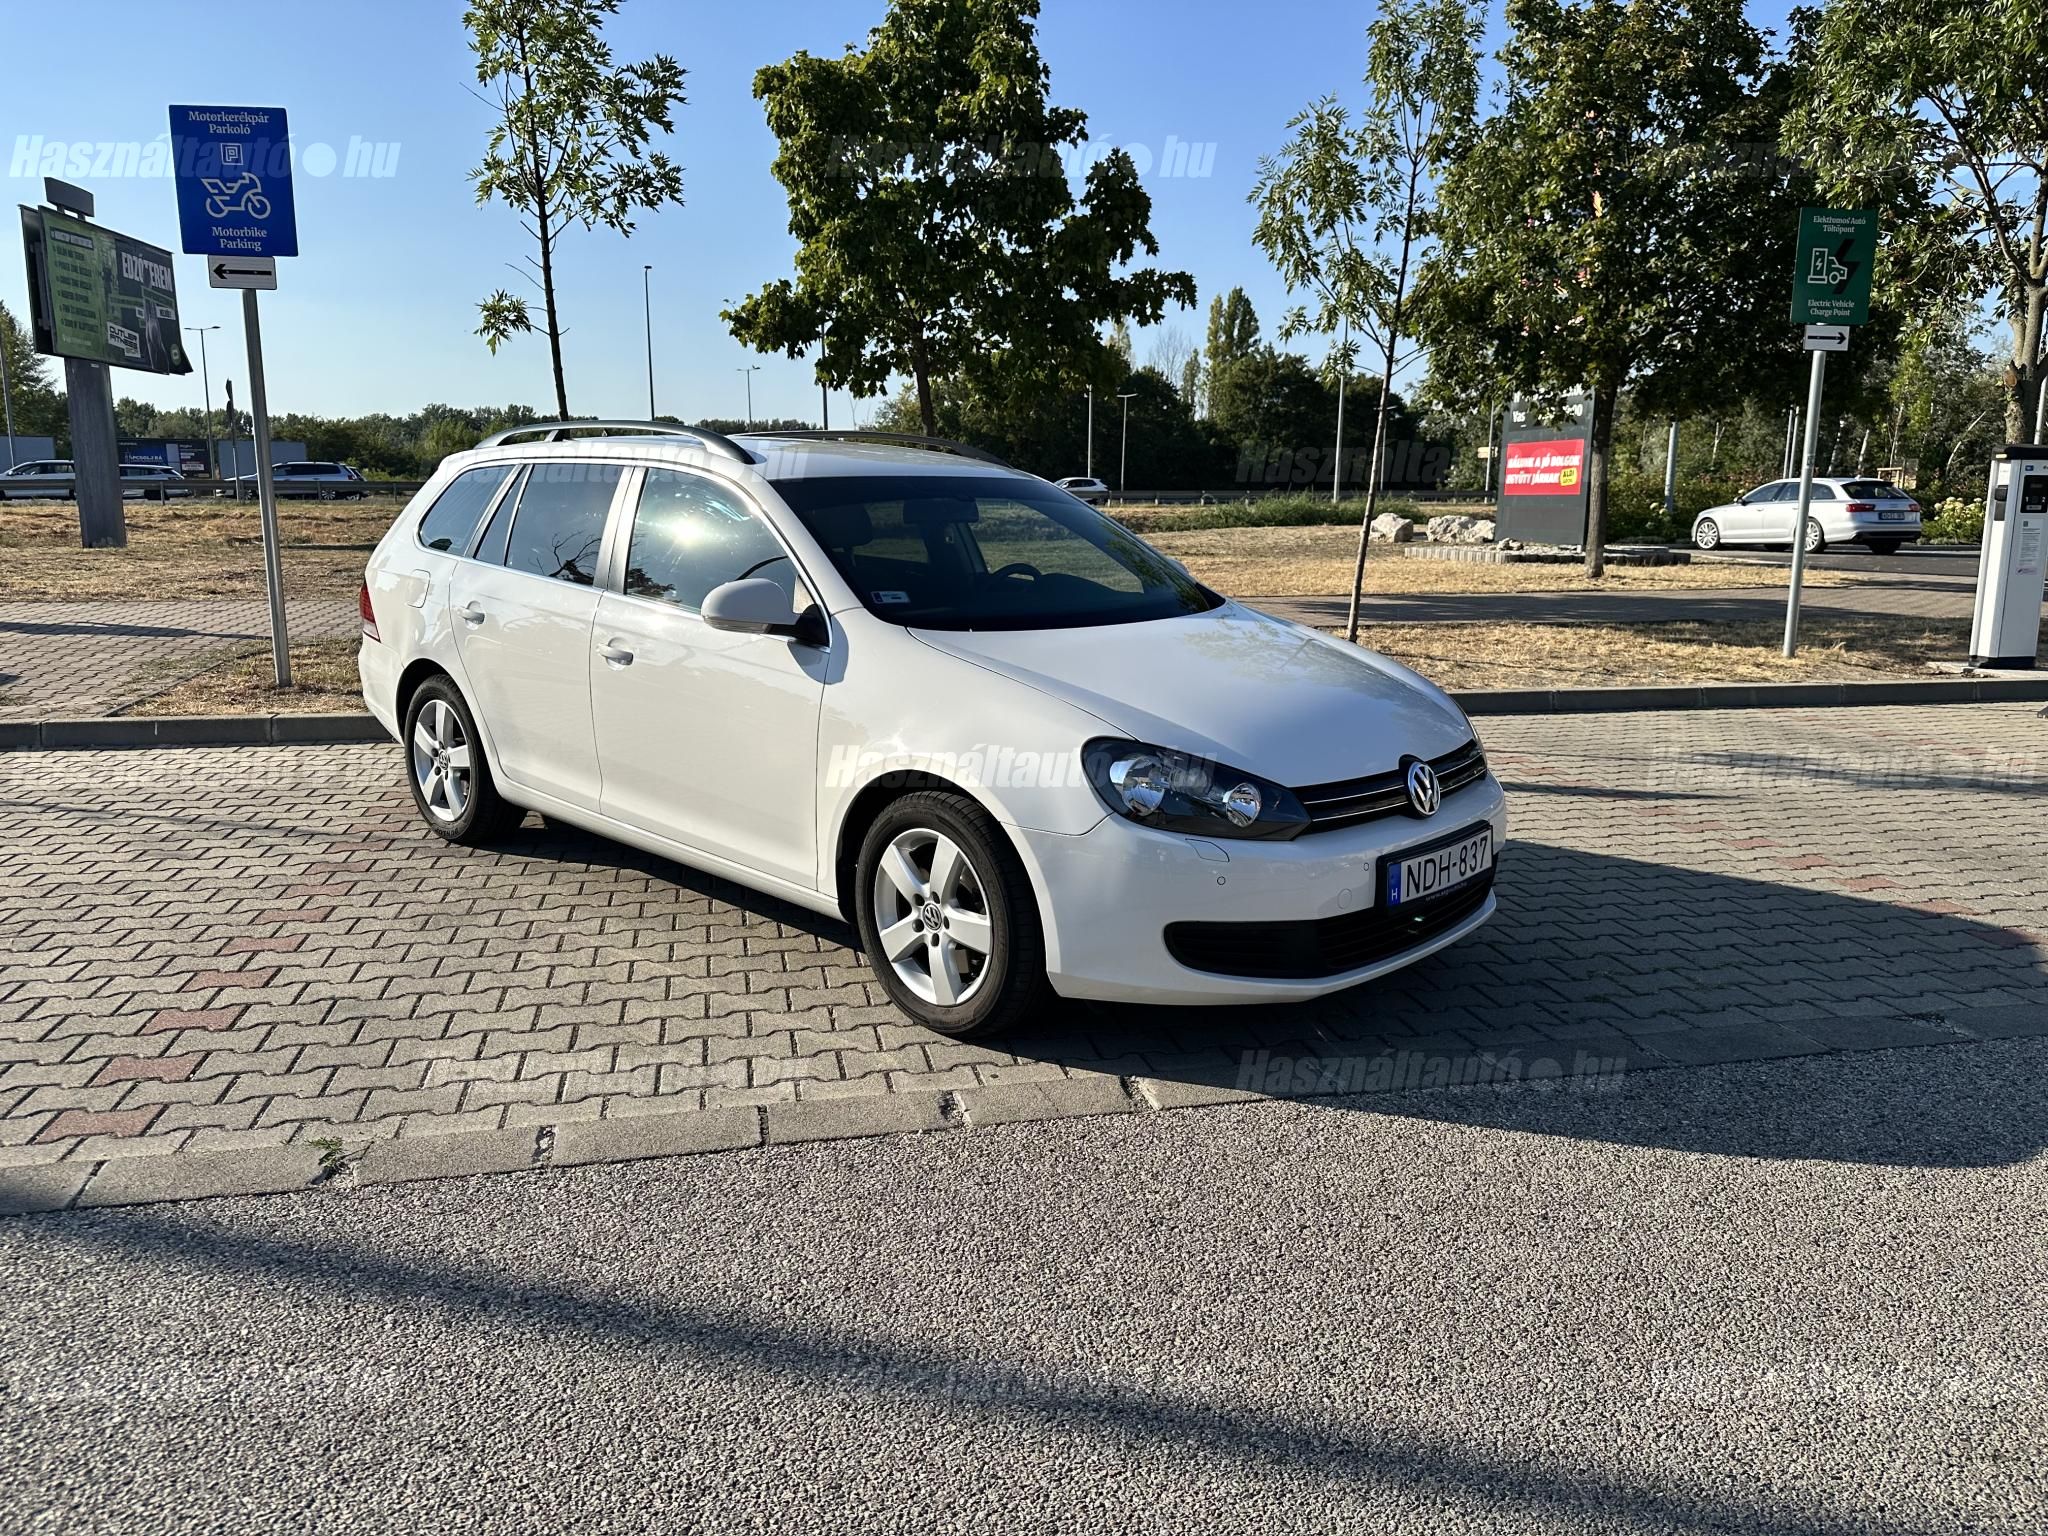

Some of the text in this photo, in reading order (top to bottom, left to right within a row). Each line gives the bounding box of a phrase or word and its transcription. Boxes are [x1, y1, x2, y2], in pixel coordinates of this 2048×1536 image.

[188, 111, 269, 125] Motorkerékpár
[208, 124, 250, 135] Parkoló
[1813, 215, 1866, 225] Elektromos Autó
[212, 226, 268, 238] Motorbike
[220, 239, 262, 252] Parking
[1808, 299, 1855, 308] Electric Vehicle
[1810, 308, 1832, 318] Charge
[1406, 834, 1488, 898] NDH-837
[1391, 887, 1399, 901] H
